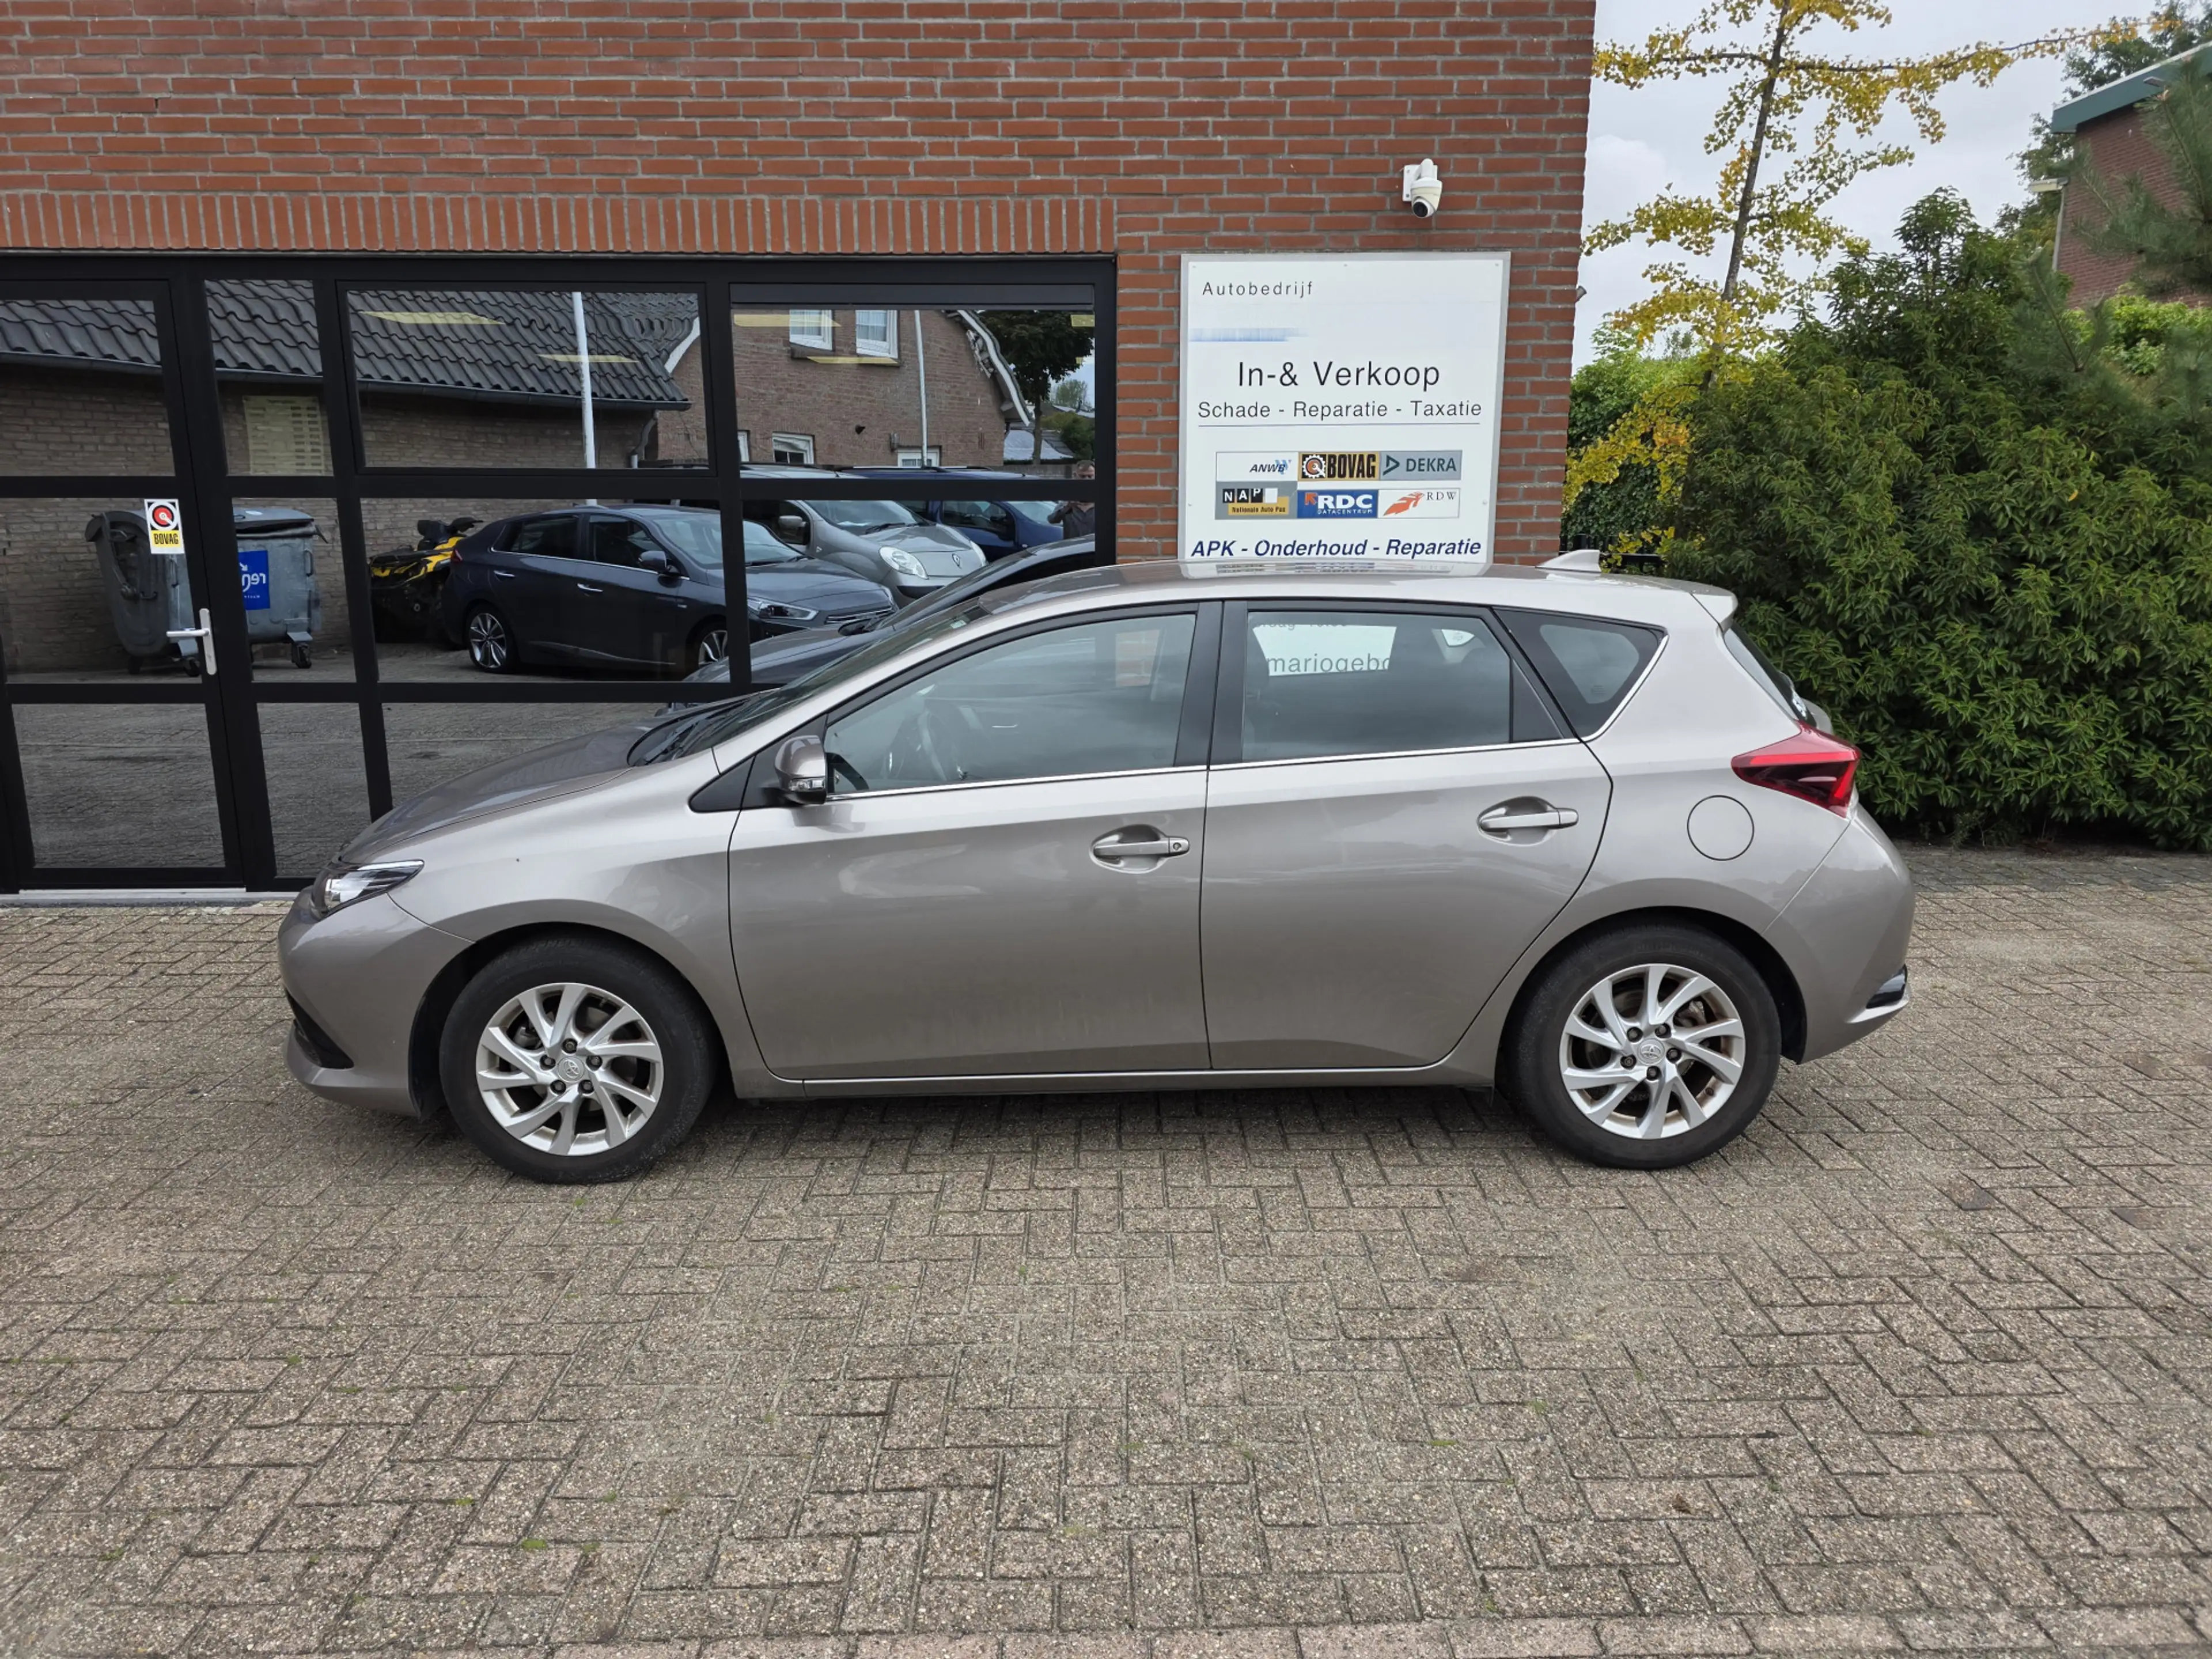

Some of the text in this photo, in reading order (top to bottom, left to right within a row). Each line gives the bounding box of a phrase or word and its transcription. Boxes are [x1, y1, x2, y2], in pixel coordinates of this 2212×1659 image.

[1202, 281, 1313, 298] Autobedrijf
[1238, 360, 1440, 392] In-& Verkoop
[1198, 402, 1271, 418] Schade
[1293, 400, 1388, 421] Reparatie
[1410, 400, 1482, 417] Taxatie
[1249, 463, 1286, 473] ANWB
[1327, 453, 1376, 478] BOVAG
[1406, 457, 1457, 472] DEKRA
[1224, 488, 1261, 501] NAP
[1318, 494, 1373, 509] RDC
[1426, 491, 1457, 501] RDW
[153, 533, 179, 545] BOVAG
[1190, 540, 1236, 557] APK
[1255, 539, 1368, 557] Onderhoud
[1385, 538, 1482, 560] Reparatie
